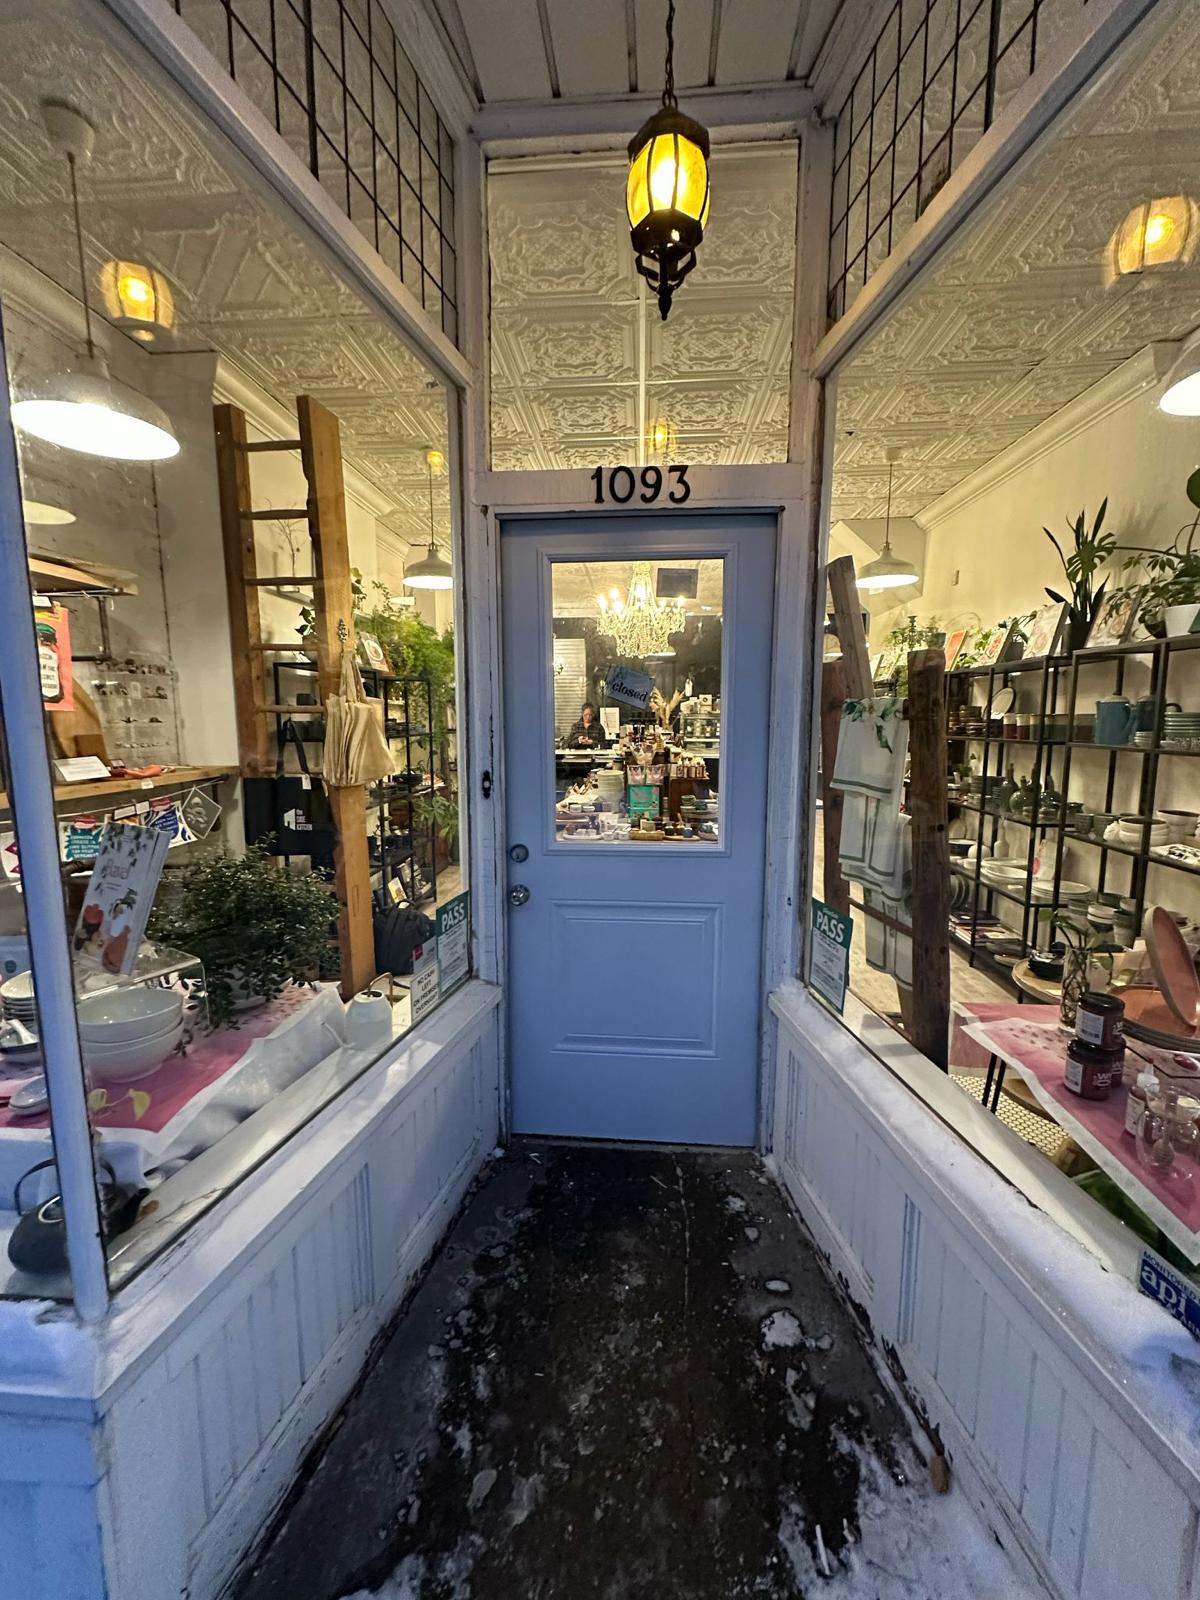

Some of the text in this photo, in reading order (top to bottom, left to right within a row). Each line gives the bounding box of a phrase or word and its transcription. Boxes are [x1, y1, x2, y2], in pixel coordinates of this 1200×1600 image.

[591, 465, 690, 504] 1093
[612, 681, 648, 702] closed
[441, 902, 465, 932] PASS
[816, 911, 845, 943] PASS
[1141, 1265, 1188, 1315] api
[1143, 1250, 1197, 1300] MONITORED
